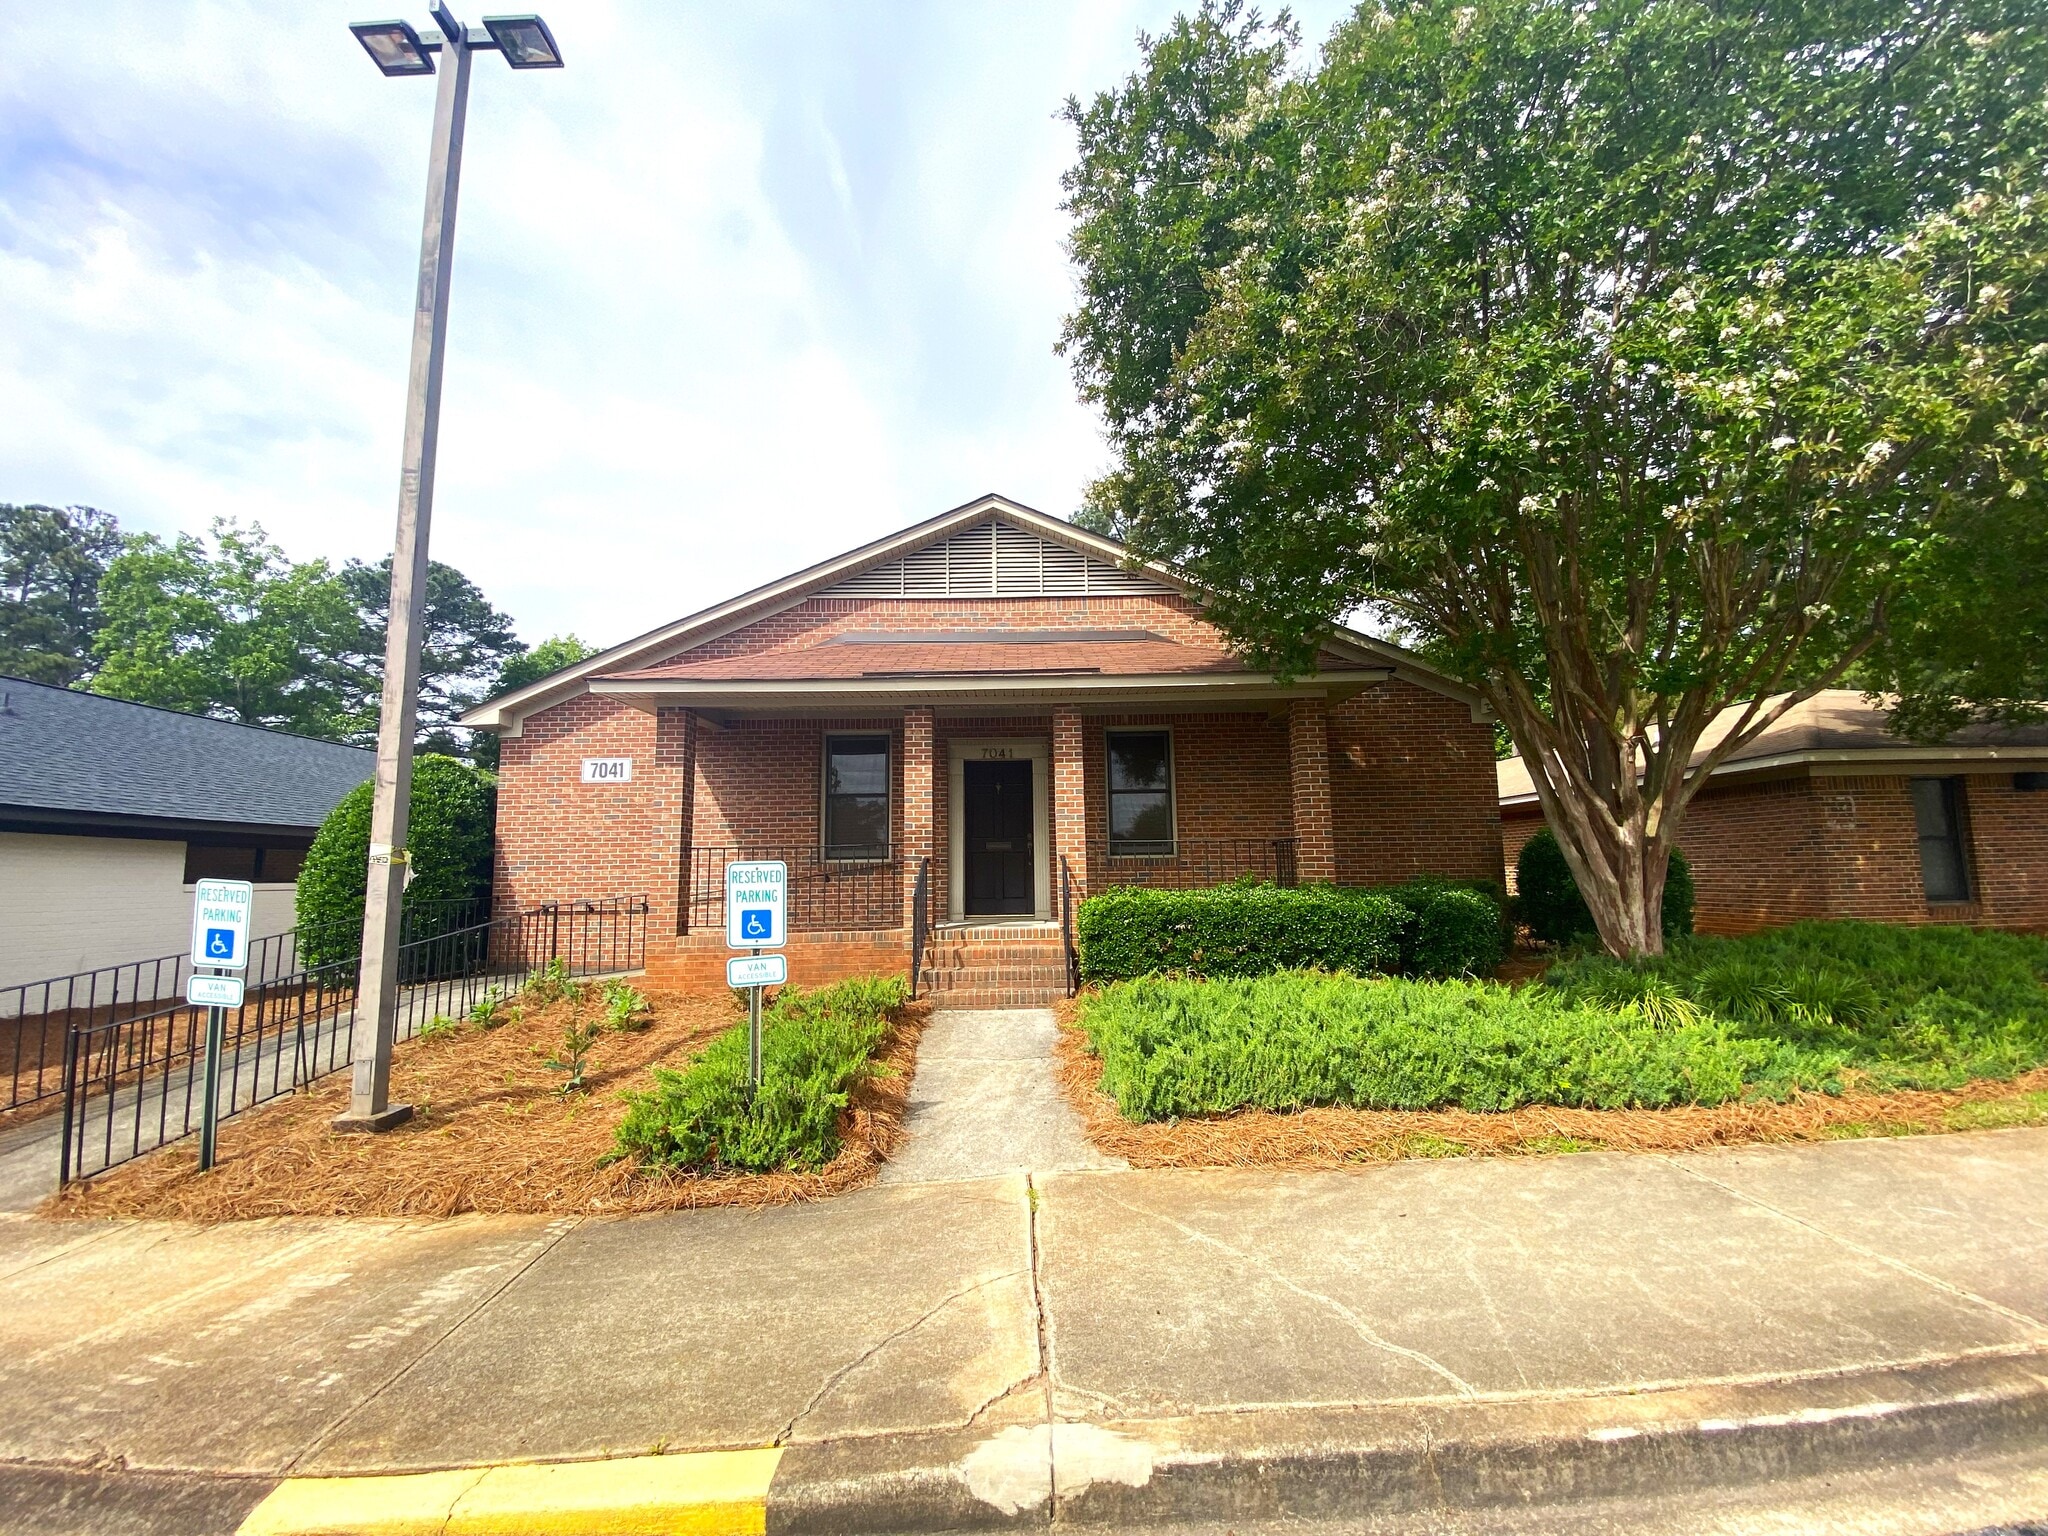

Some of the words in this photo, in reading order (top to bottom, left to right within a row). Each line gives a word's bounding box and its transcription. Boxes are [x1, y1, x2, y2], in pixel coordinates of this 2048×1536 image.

[981, 747, 1013, 759] 7041
[590, 762, 624, 778] 7041
[731, 870, 782, 884] RESERVED
[200, 887, 247, 904] RESERVED
[735, 889, 778, 903] PARKING
[202, 907, 242, 923] PARKING
[747, 963, 767, 972] VAN
[738, 971, 777, 980] ACCESSIBLE
[208, 983, 226, 992] VAN
